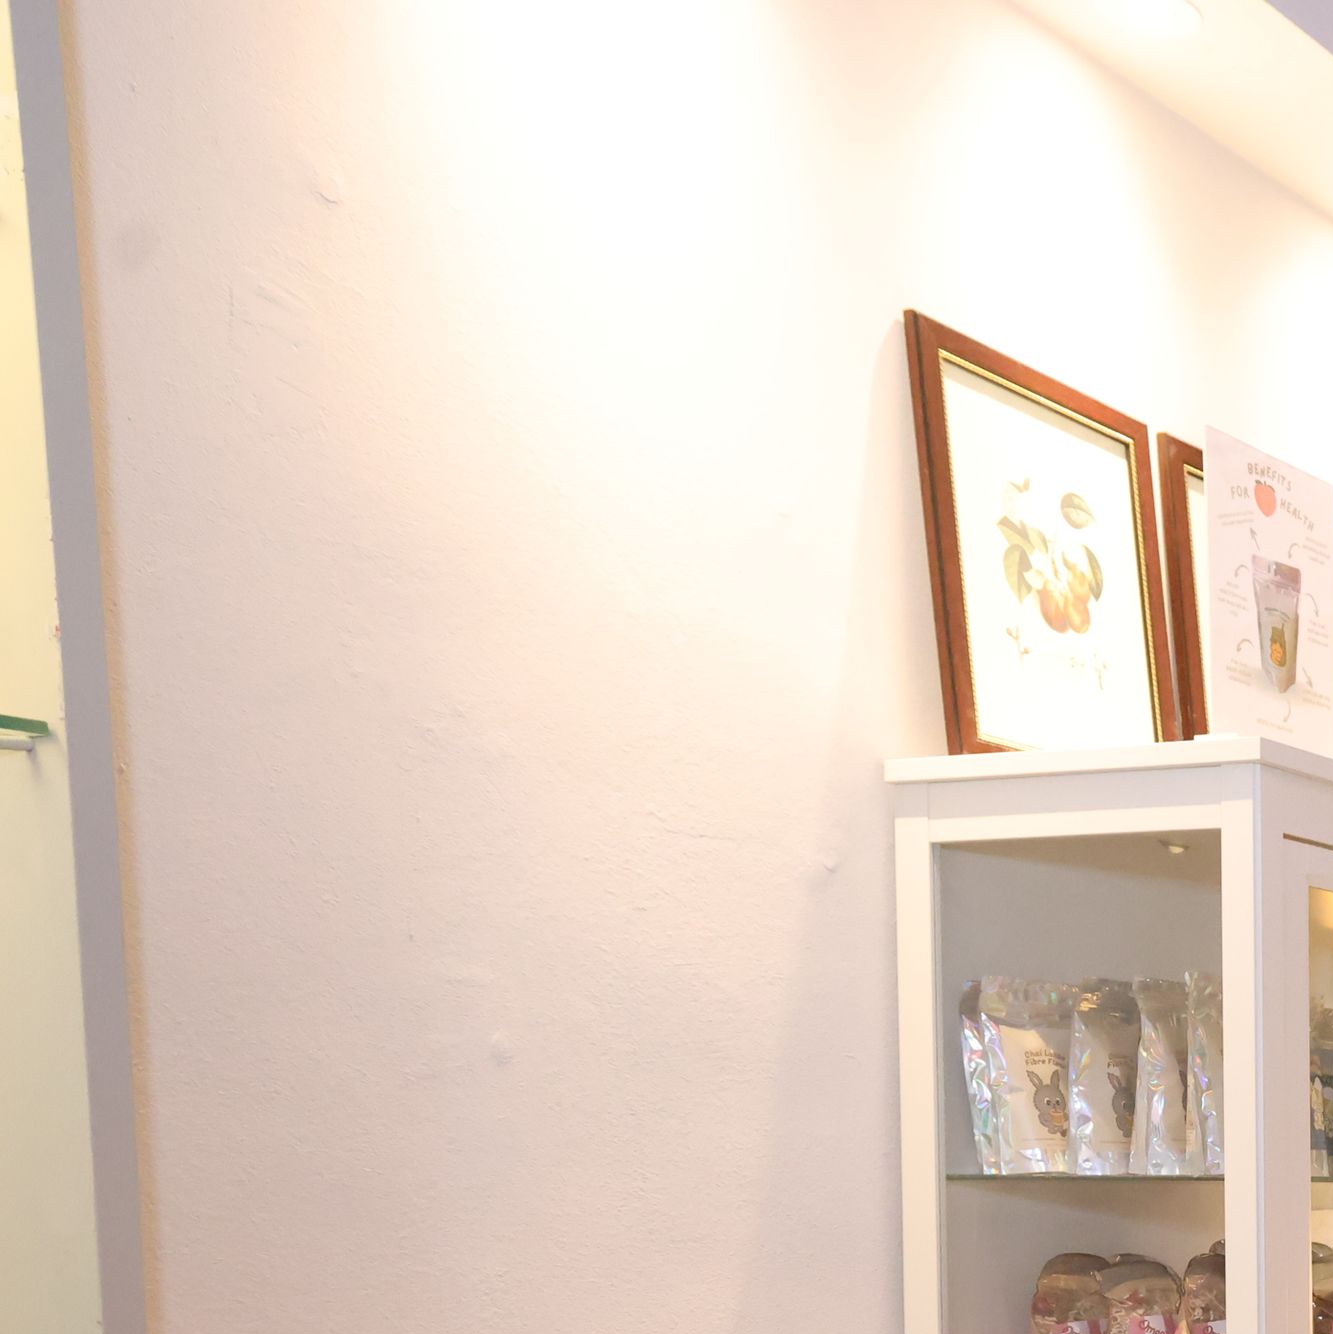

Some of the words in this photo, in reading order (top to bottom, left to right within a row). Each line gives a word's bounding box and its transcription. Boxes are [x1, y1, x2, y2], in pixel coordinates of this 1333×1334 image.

[1247, 462, 1292, 493] BENEFITS
[1230, 485, 1250, 500] FOR
[1280, 497, 1315, 533] HEALTH
